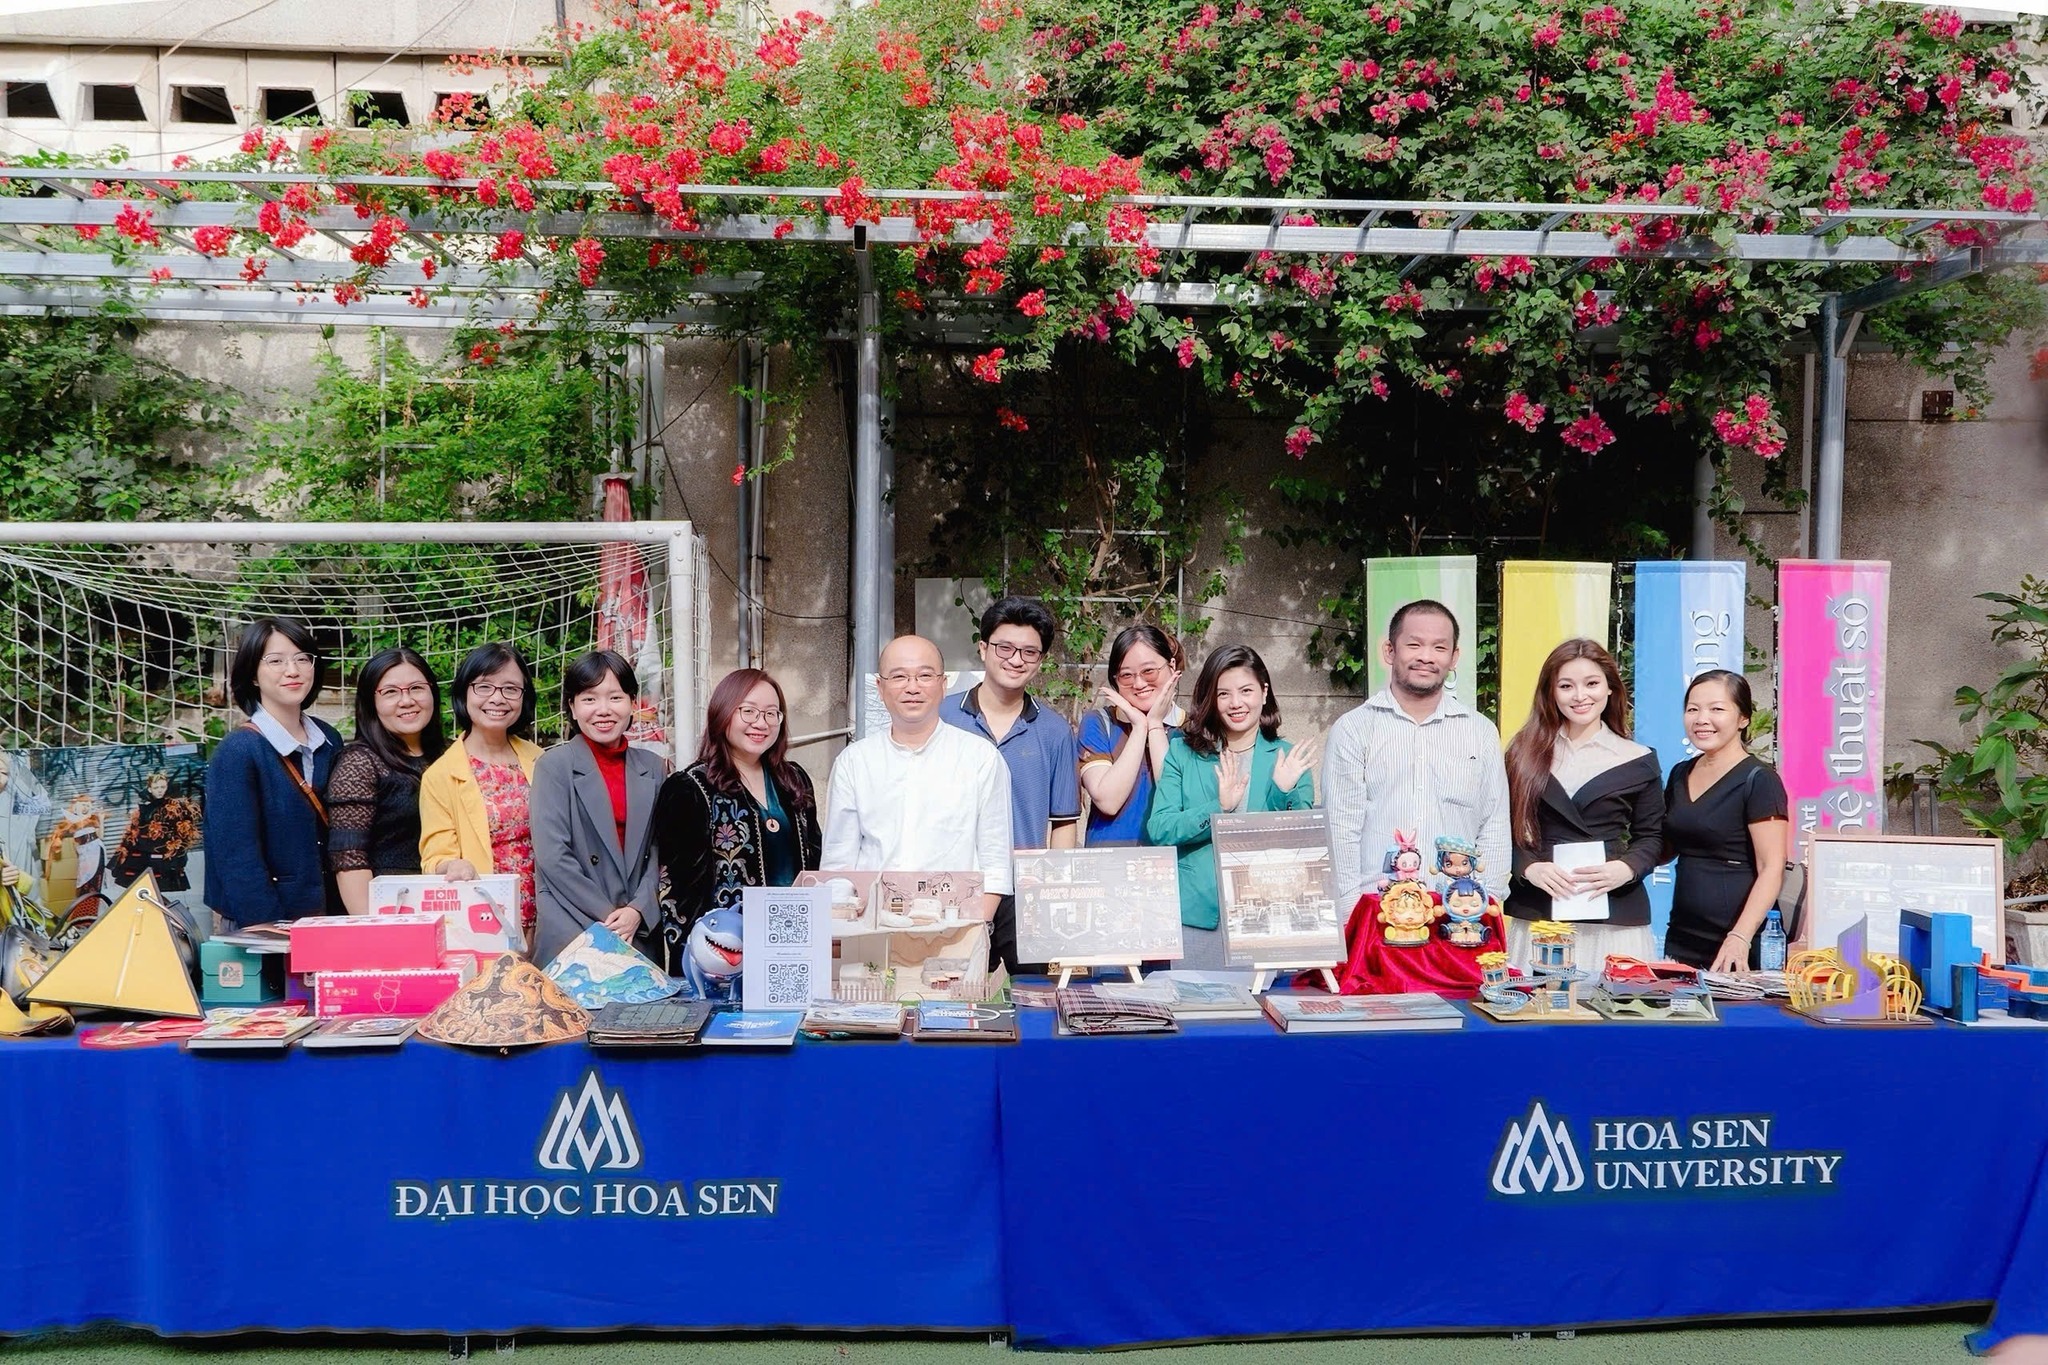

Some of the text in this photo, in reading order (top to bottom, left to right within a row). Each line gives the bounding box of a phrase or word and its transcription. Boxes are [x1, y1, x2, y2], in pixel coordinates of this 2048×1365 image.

[1826, 594, 1869, 650] số
[1829, 663, 1876, 778] thuật
[1801, 804, 1817, 834] Art
[1595, 1119, 1771, 1151] HOA SEN
[1595, 1156, 1842, 1190] UNIVERSITY
[395, 1183, 778, 1221] ĐẠI HỌC HOA SEN
